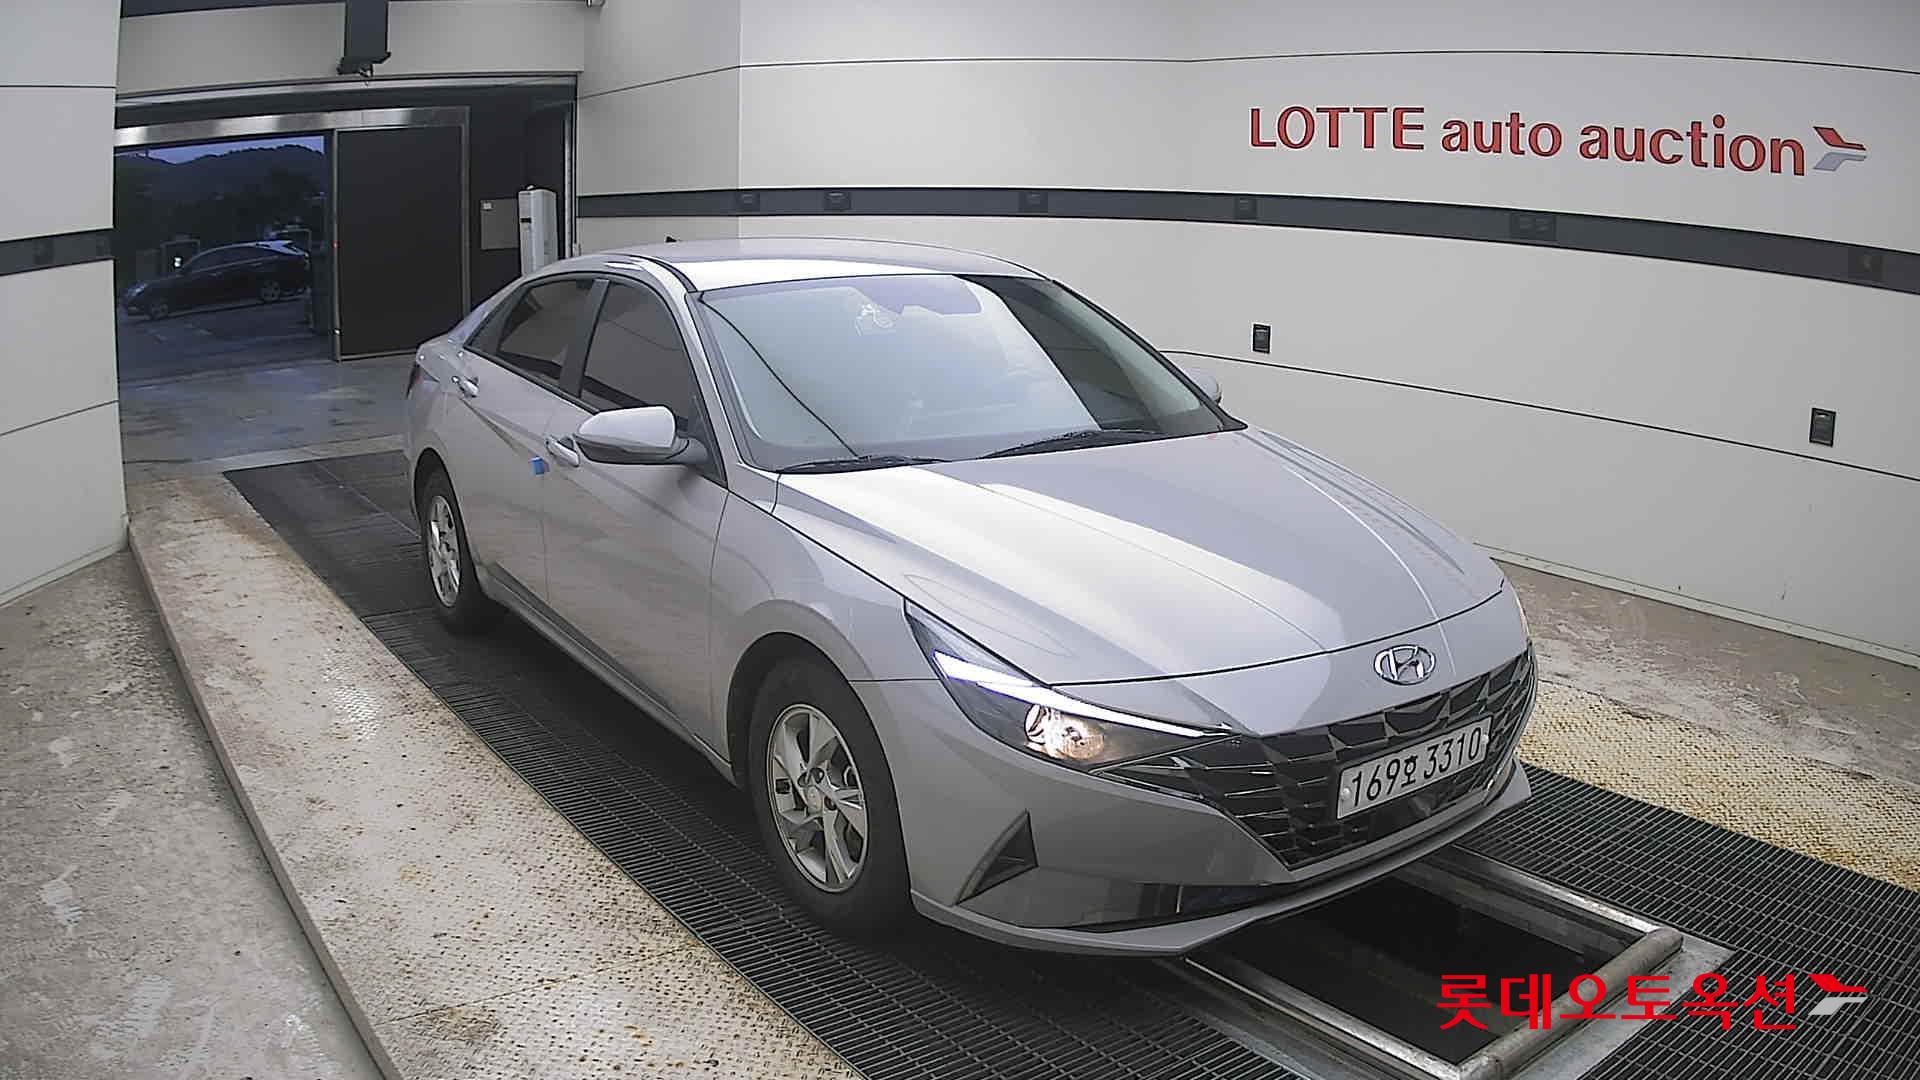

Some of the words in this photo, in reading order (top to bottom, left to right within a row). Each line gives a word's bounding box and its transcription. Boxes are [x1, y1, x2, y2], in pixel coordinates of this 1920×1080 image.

[1249, 105, 1425, 150] LOTTE
[1441, 111, 1563, 157] auto
[1579, 114, 1806, 176] auction
[1352, 754, 1419, 807] 169호
[1423, 726, 1482, 779] 3310
